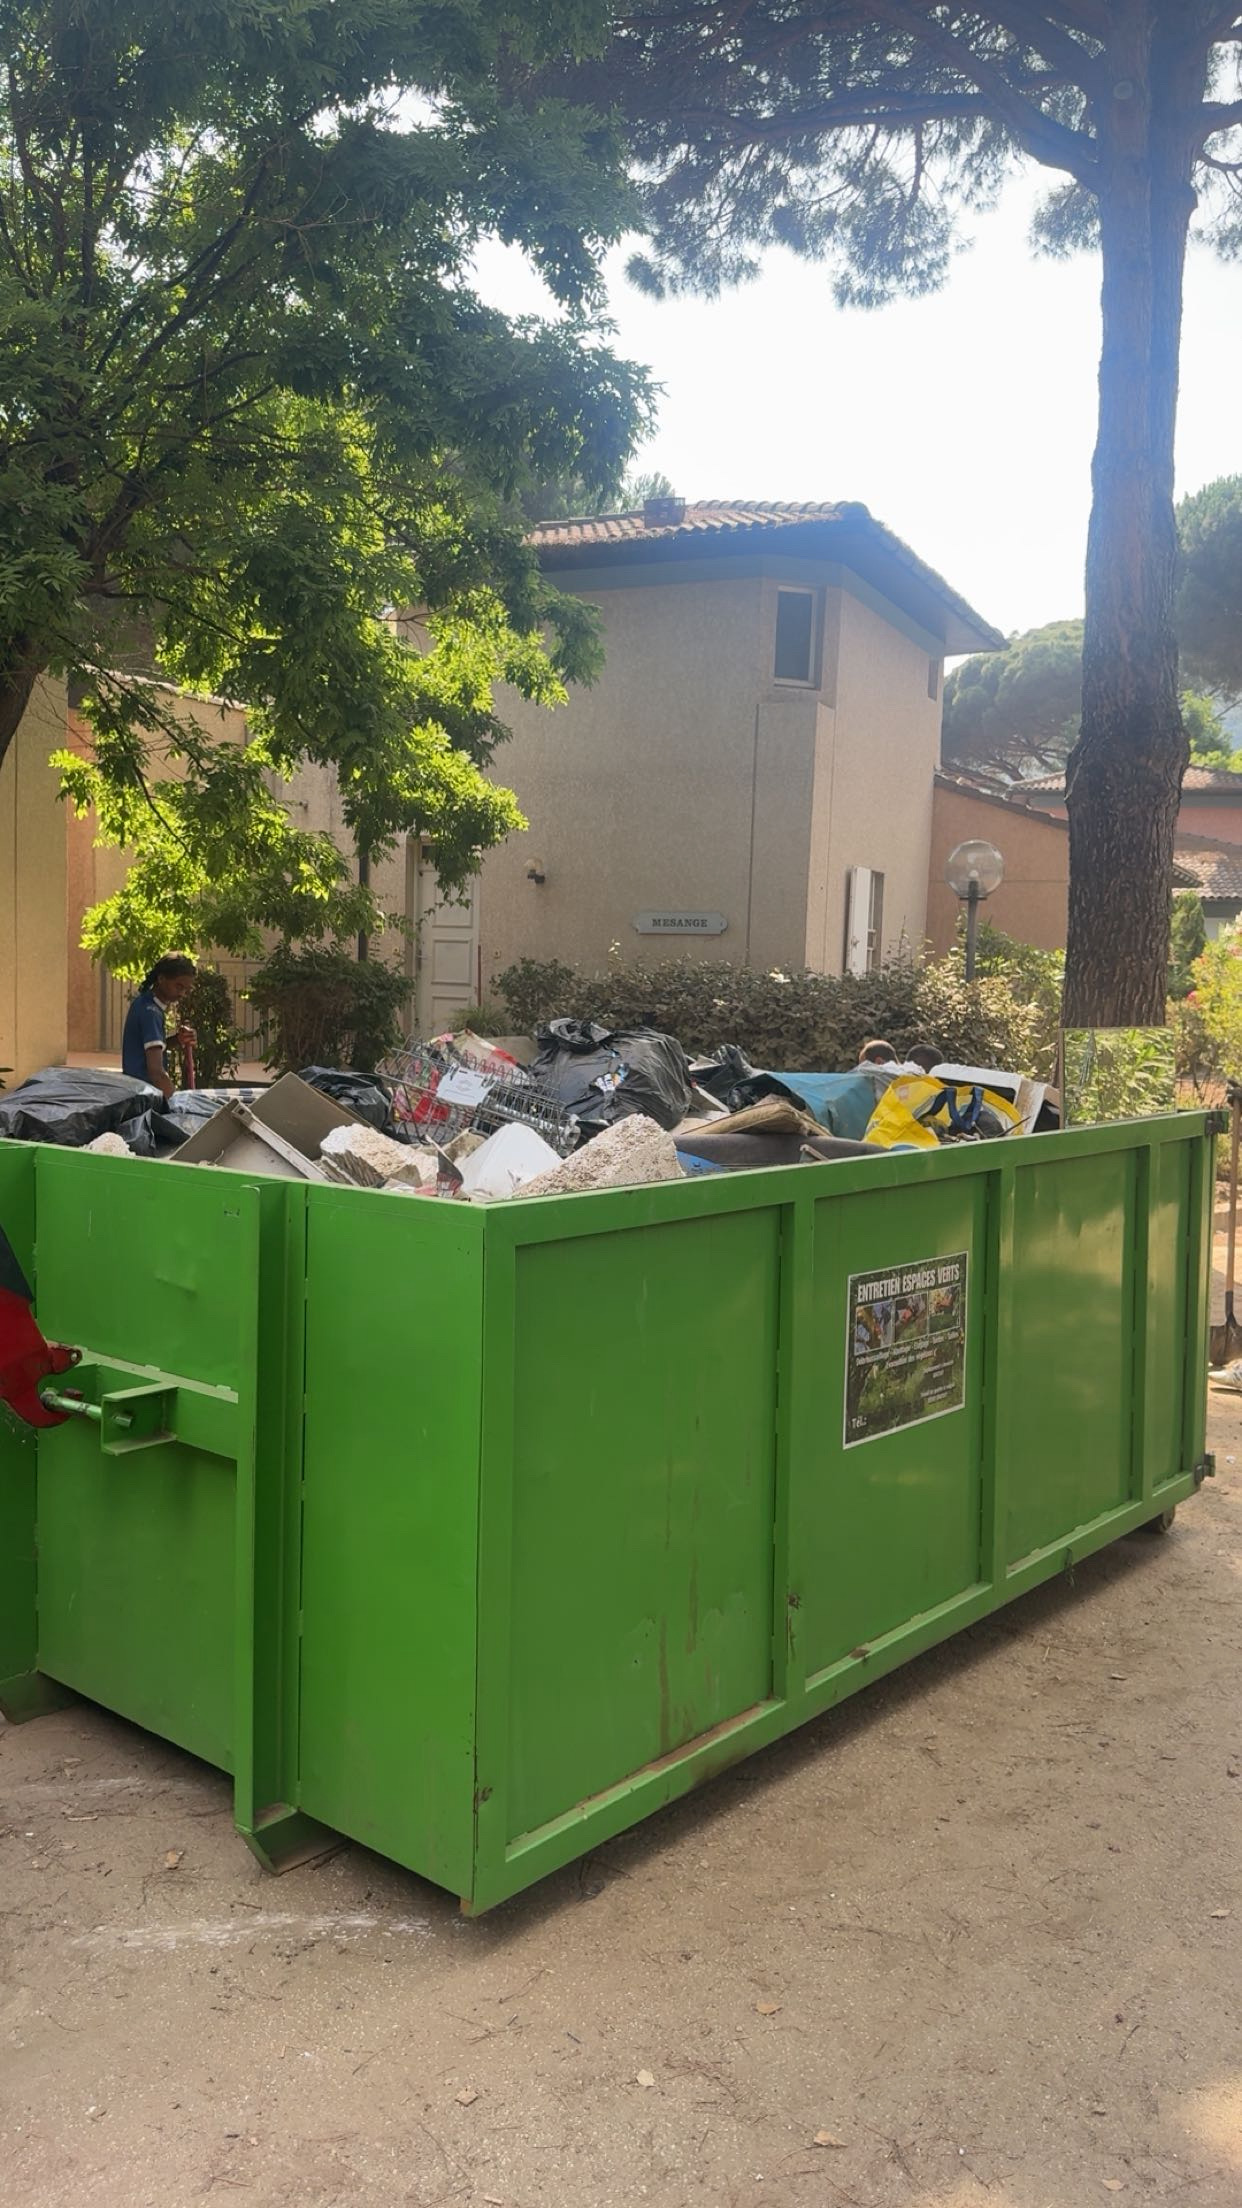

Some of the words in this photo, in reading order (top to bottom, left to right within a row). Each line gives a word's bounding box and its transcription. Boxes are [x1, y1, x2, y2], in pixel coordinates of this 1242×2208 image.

[651, 918, 708, 928] MESANGE
[857, 1277, 901, 1303] ENTRETIEN
[902, 1269, 936, 1293] ESPACES
[937, 1263, 959, 1284] VERTS
